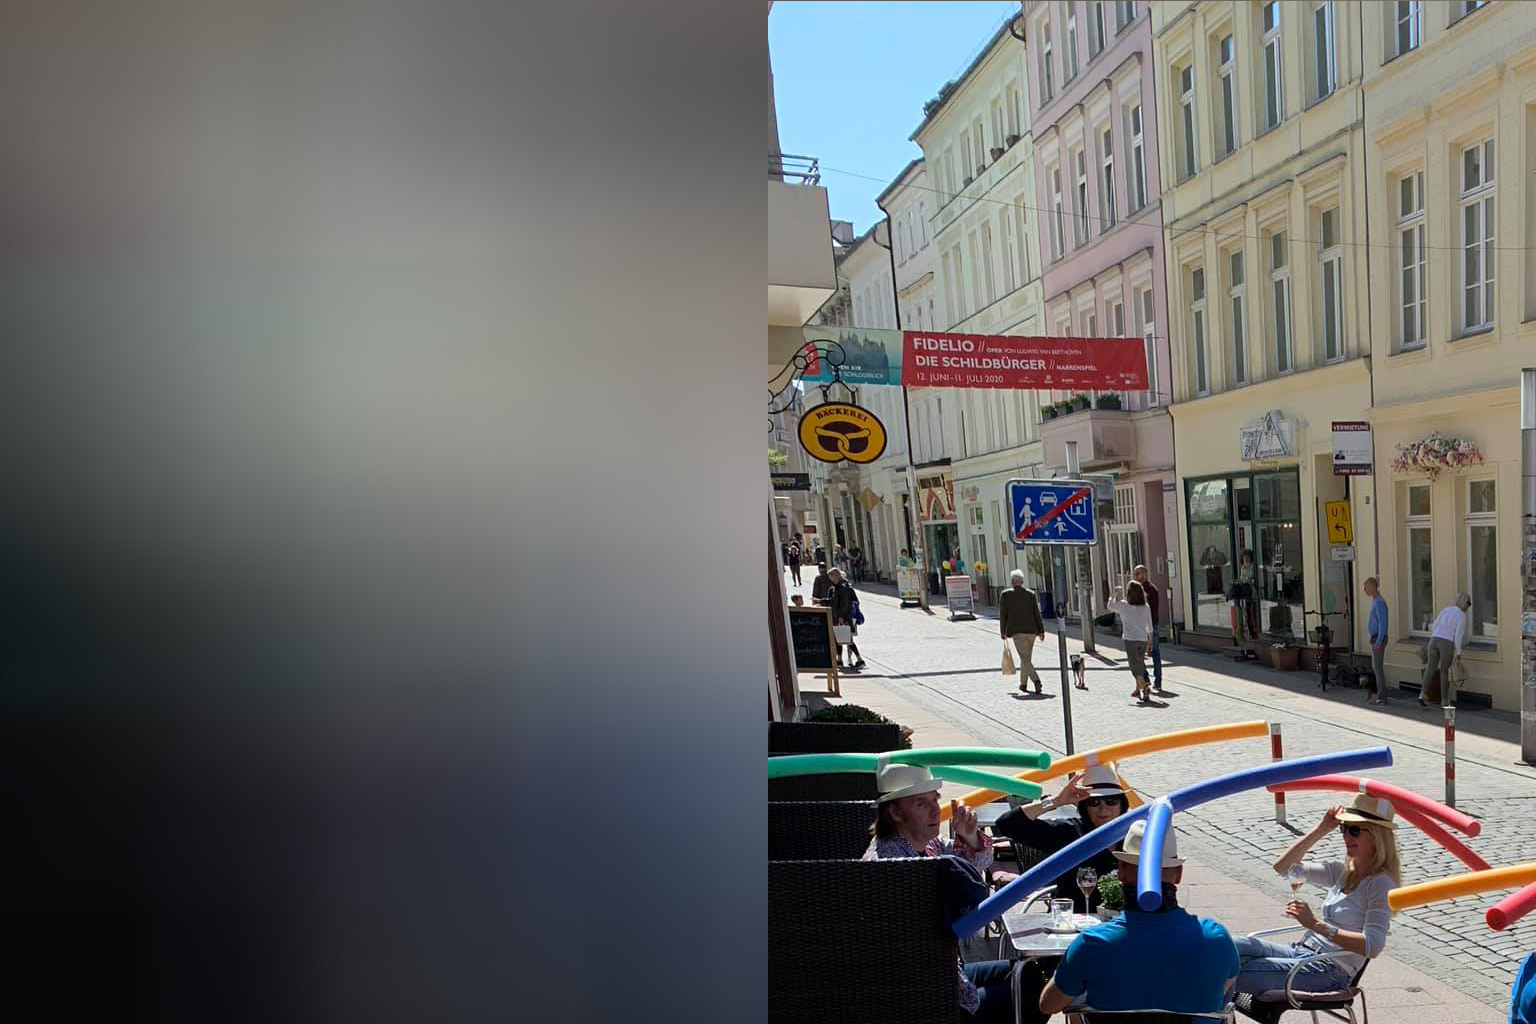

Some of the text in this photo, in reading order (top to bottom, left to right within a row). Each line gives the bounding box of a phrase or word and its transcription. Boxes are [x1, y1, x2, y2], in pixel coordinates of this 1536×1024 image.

[913, 337, 974, 352] FIDELIO
[915, 355, 939, 367] DIE
[942, 356, 1046, 370] SCHILDBÜRGER
[917, 372, 928, 380] 12.
[966, 375, 983, 384] JULI
[985, 375, 1004, 383] 2020
[816, 408, 868, 422] BÄCKEREI
